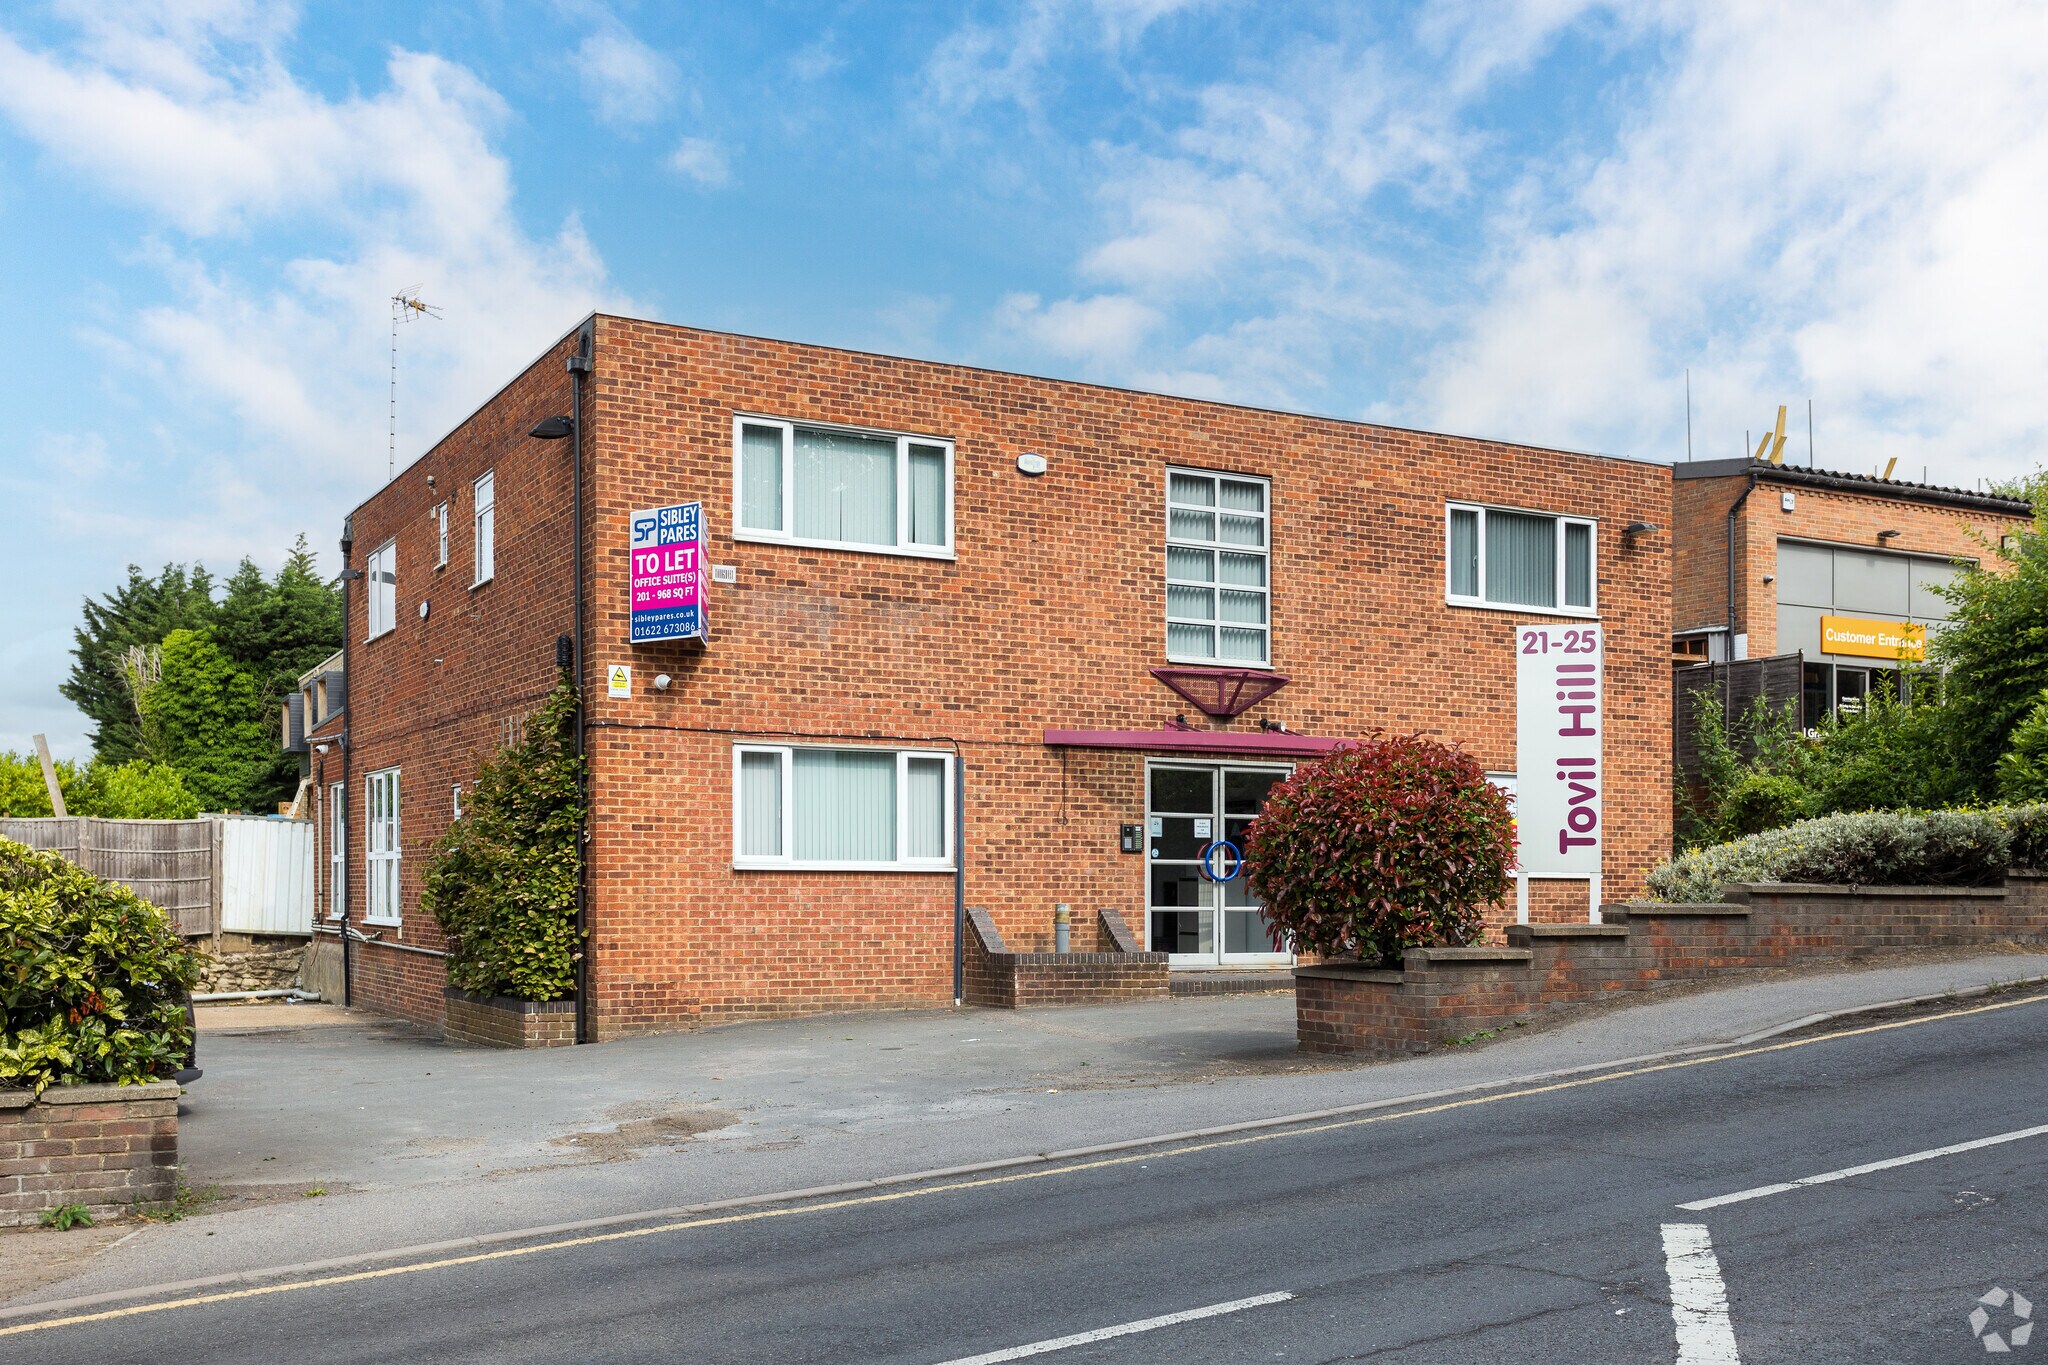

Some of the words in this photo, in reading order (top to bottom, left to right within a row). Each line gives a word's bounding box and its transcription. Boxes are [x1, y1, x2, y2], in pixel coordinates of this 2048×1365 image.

[660, 506, 697, 526] SIBLEY
[660, 524, 697, 544] PARES
[635, 553, 660, 574] TO
[665, 548, 695, 572] LET
[634, 576, 661, 588] OFFICE
[662, 572, 696, 585] SUITE(S)
[636, 591, 650, 601] 201
[657, 589, 671, 600] 968
[673, 587, 684, 599] SQ
[685, 586, 694, 596] FT
[634, 610, 694, 623] sibleypares.co.uk
[635, 625, 661, 636] 01622
[663, 622, 696, 634] 673086
[1825, 628, 1876, 645] Customer
[1522, 630, 1596, 654] 21-25
[1556, 664, 1596, 737] Hill
[1556, 758, 1597, 855] Tovil
